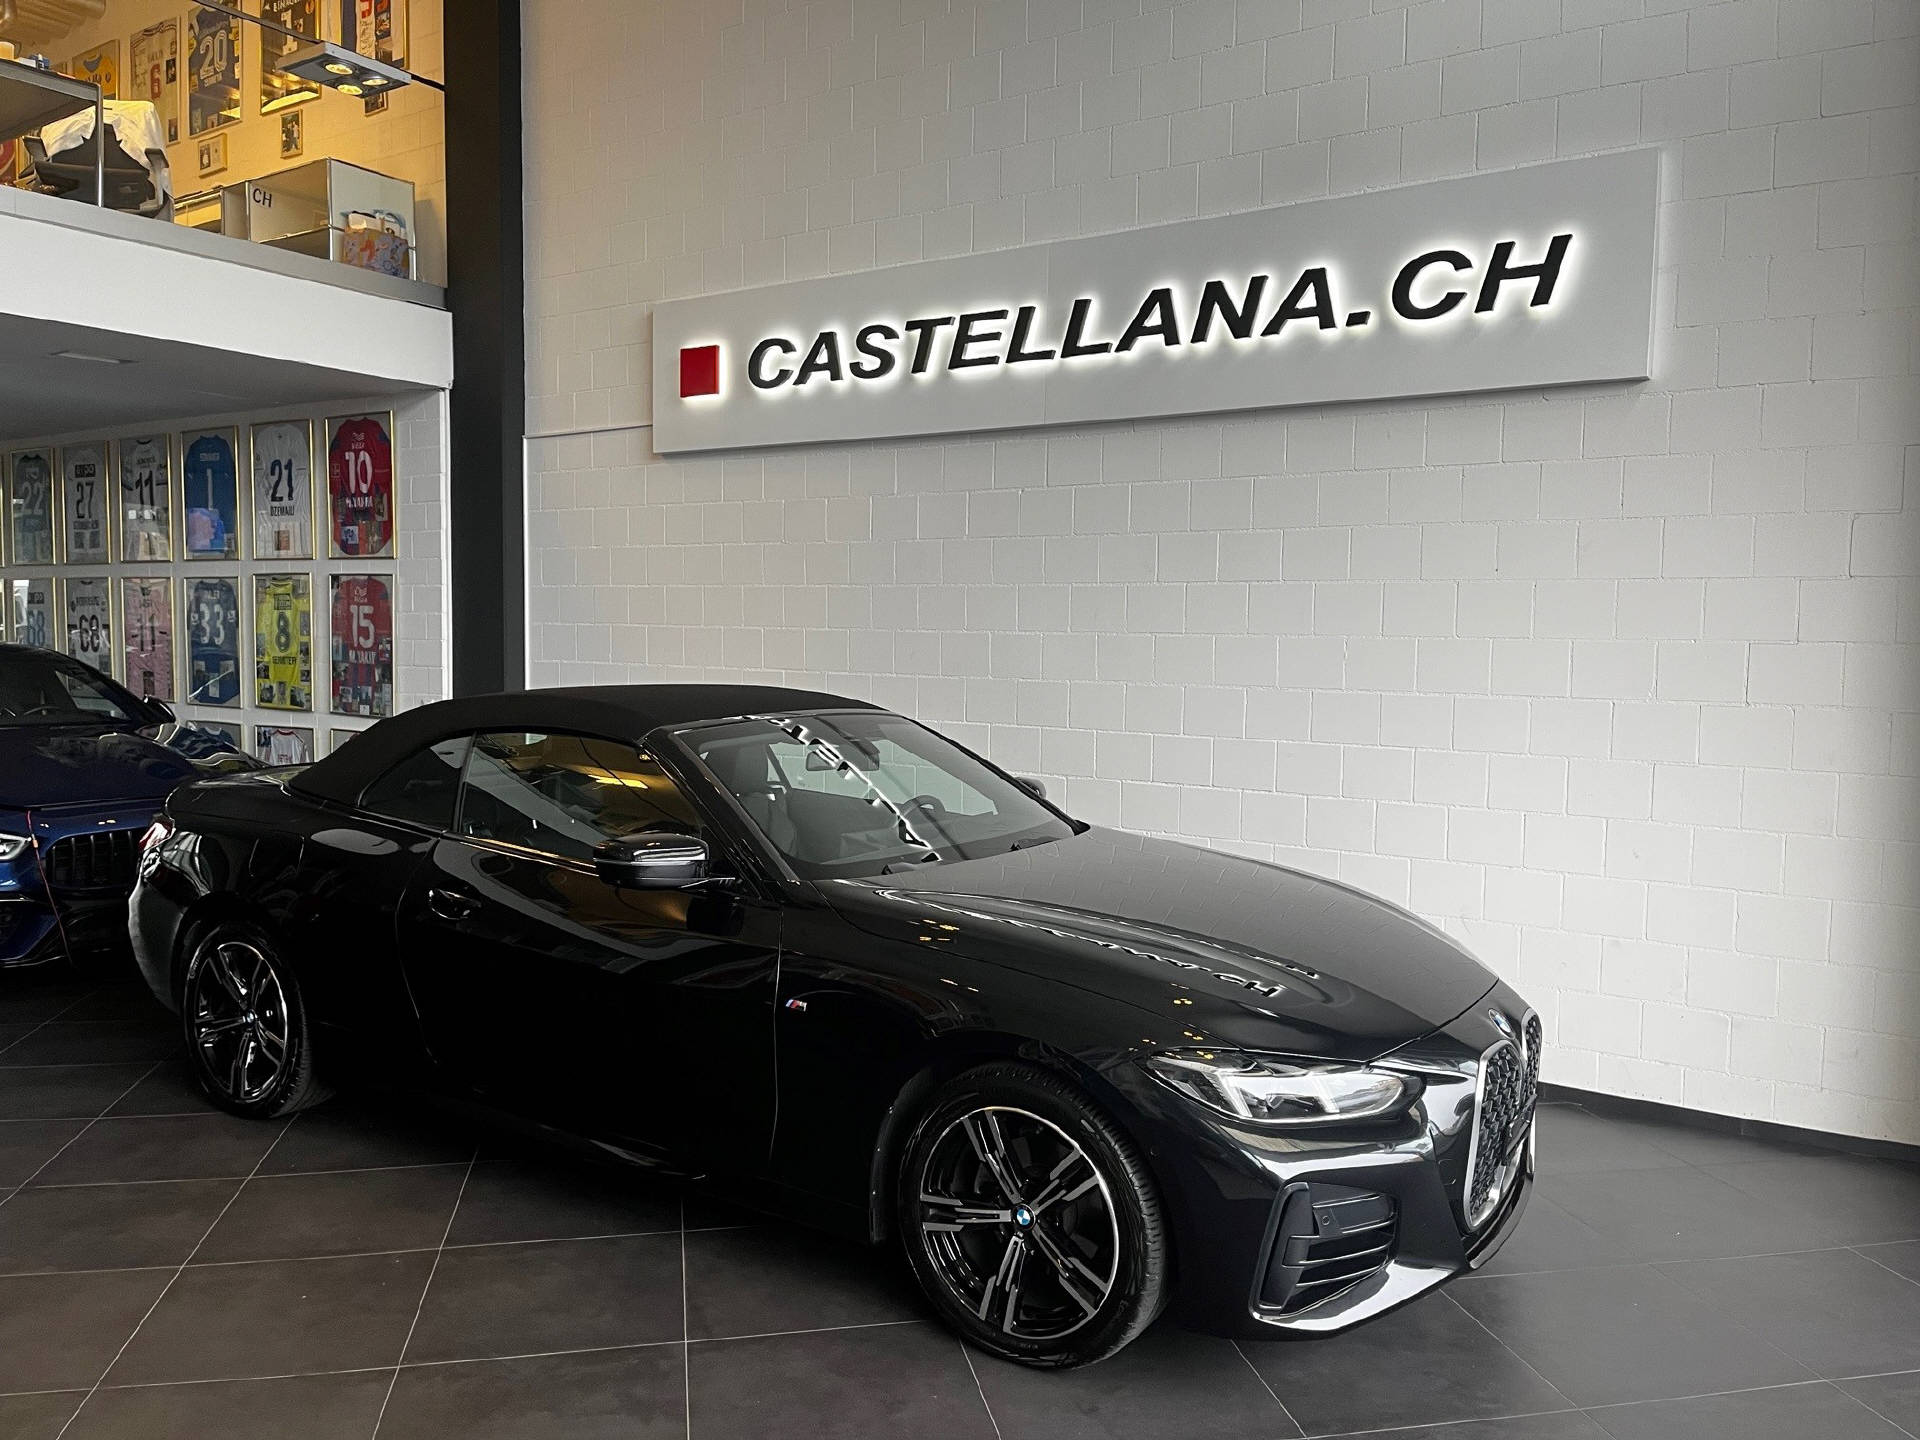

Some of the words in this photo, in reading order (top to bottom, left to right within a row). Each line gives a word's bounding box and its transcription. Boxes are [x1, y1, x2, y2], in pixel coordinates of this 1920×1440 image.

[200, 29, 228, 80] 20
[151, 63, 161, 100] 6
[252, 188, 272, 208] CH
[748, 234, 1573, 389] CASTELLANA.CH
[270, 458, 294, 502] 21
[345, 450, 373, 494] 10
[77, 480, 94, 518] 27
[200, 603, 225, 645] 33
[275, 611, 291, 653] 8
[349, 604, 375, 648] 15
